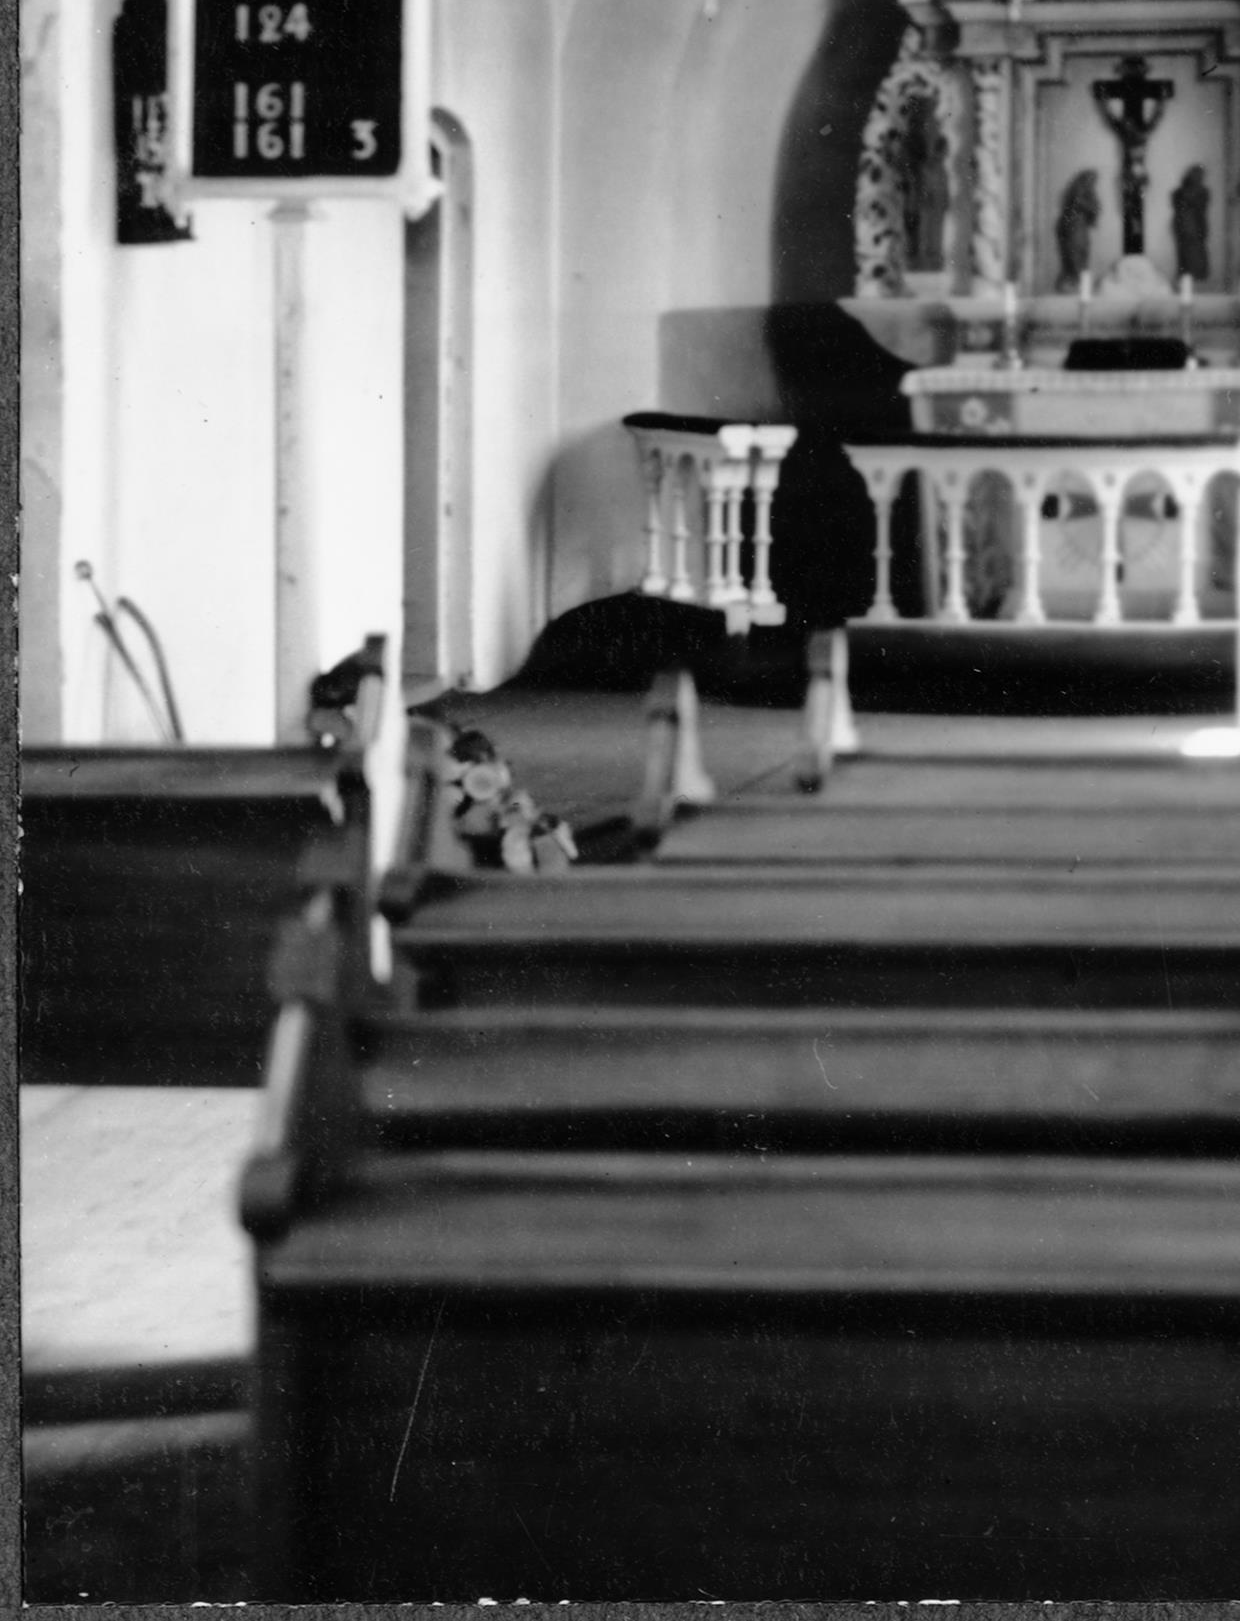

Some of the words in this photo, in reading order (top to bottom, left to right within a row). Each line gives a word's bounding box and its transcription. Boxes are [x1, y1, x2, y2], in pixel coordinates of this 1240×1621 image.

[235, 2, 313, 43] 124
[233, 82, 305, 119] 161
[233, 121, 305, 159] 161
[350, 119, 377, 160] 3
